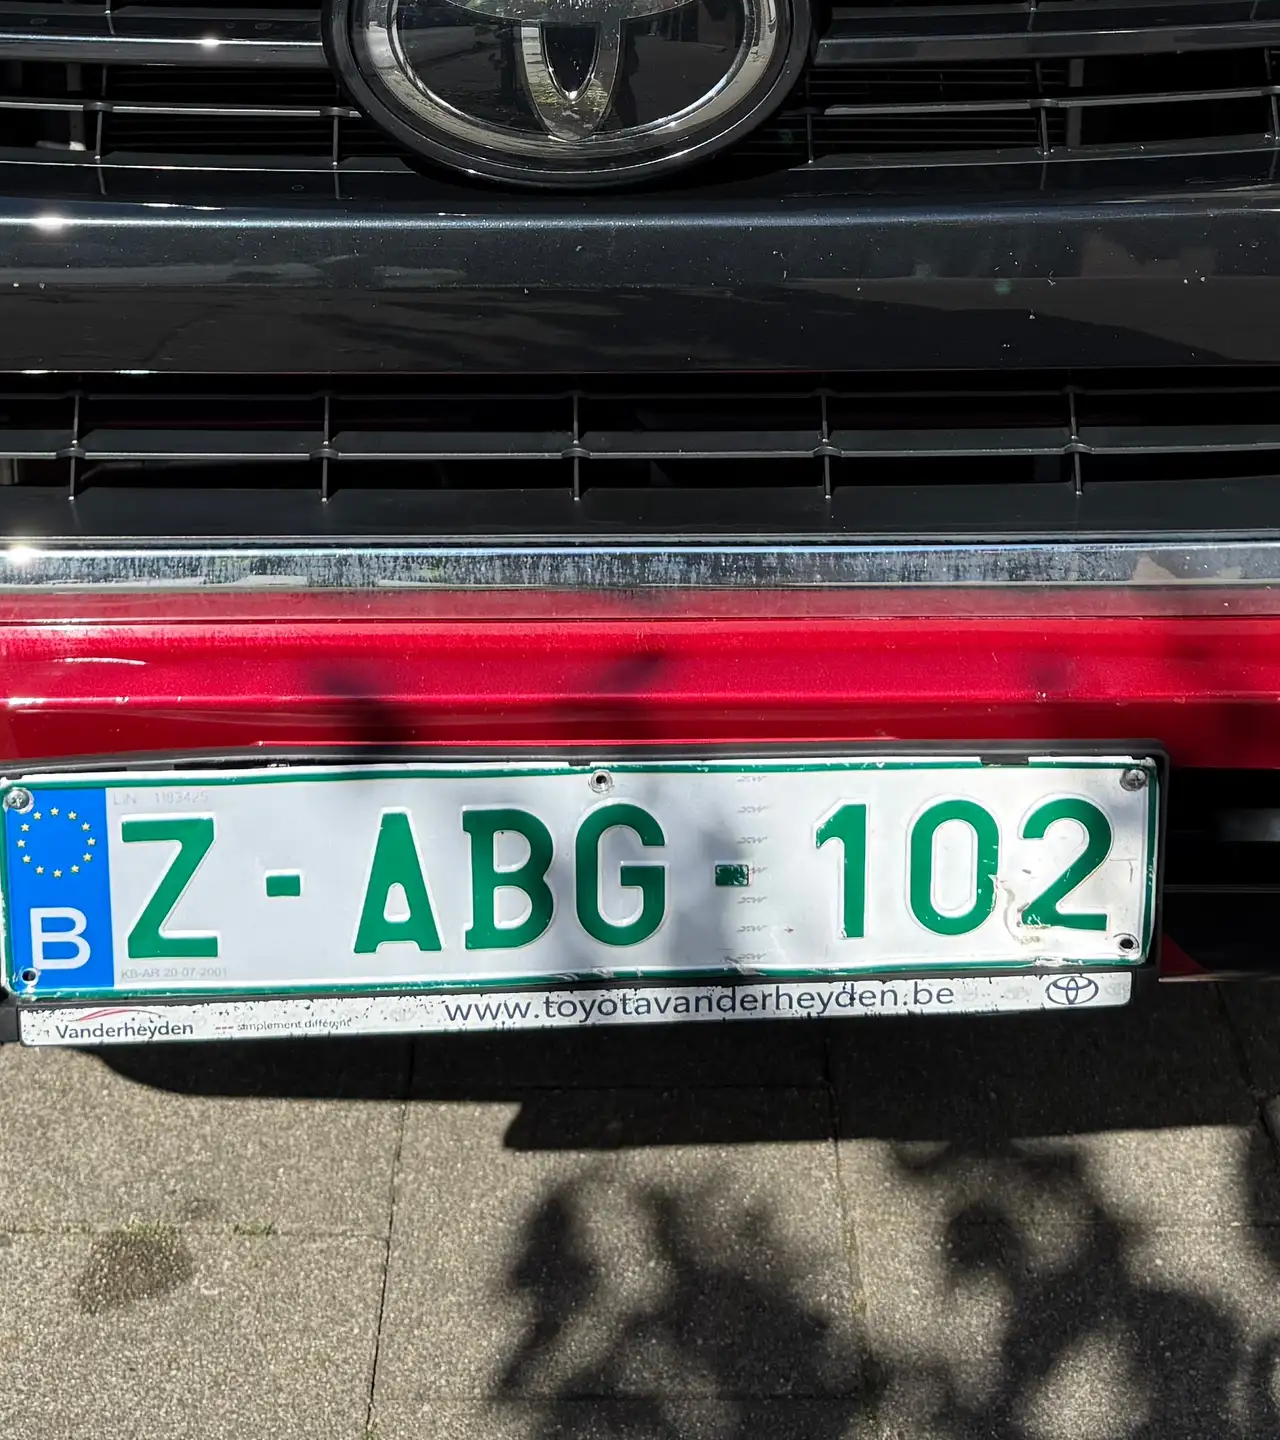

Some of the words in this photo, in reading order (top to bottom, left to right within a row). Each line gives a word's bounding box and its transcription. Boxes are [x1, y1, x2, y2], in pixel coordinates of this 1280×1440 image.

[30, 907, 92, 970] B
[443, 981, 955, 1024] www.toyotavanderheyden.be
[55, 1022, 194, 1039] Vanderheyden
